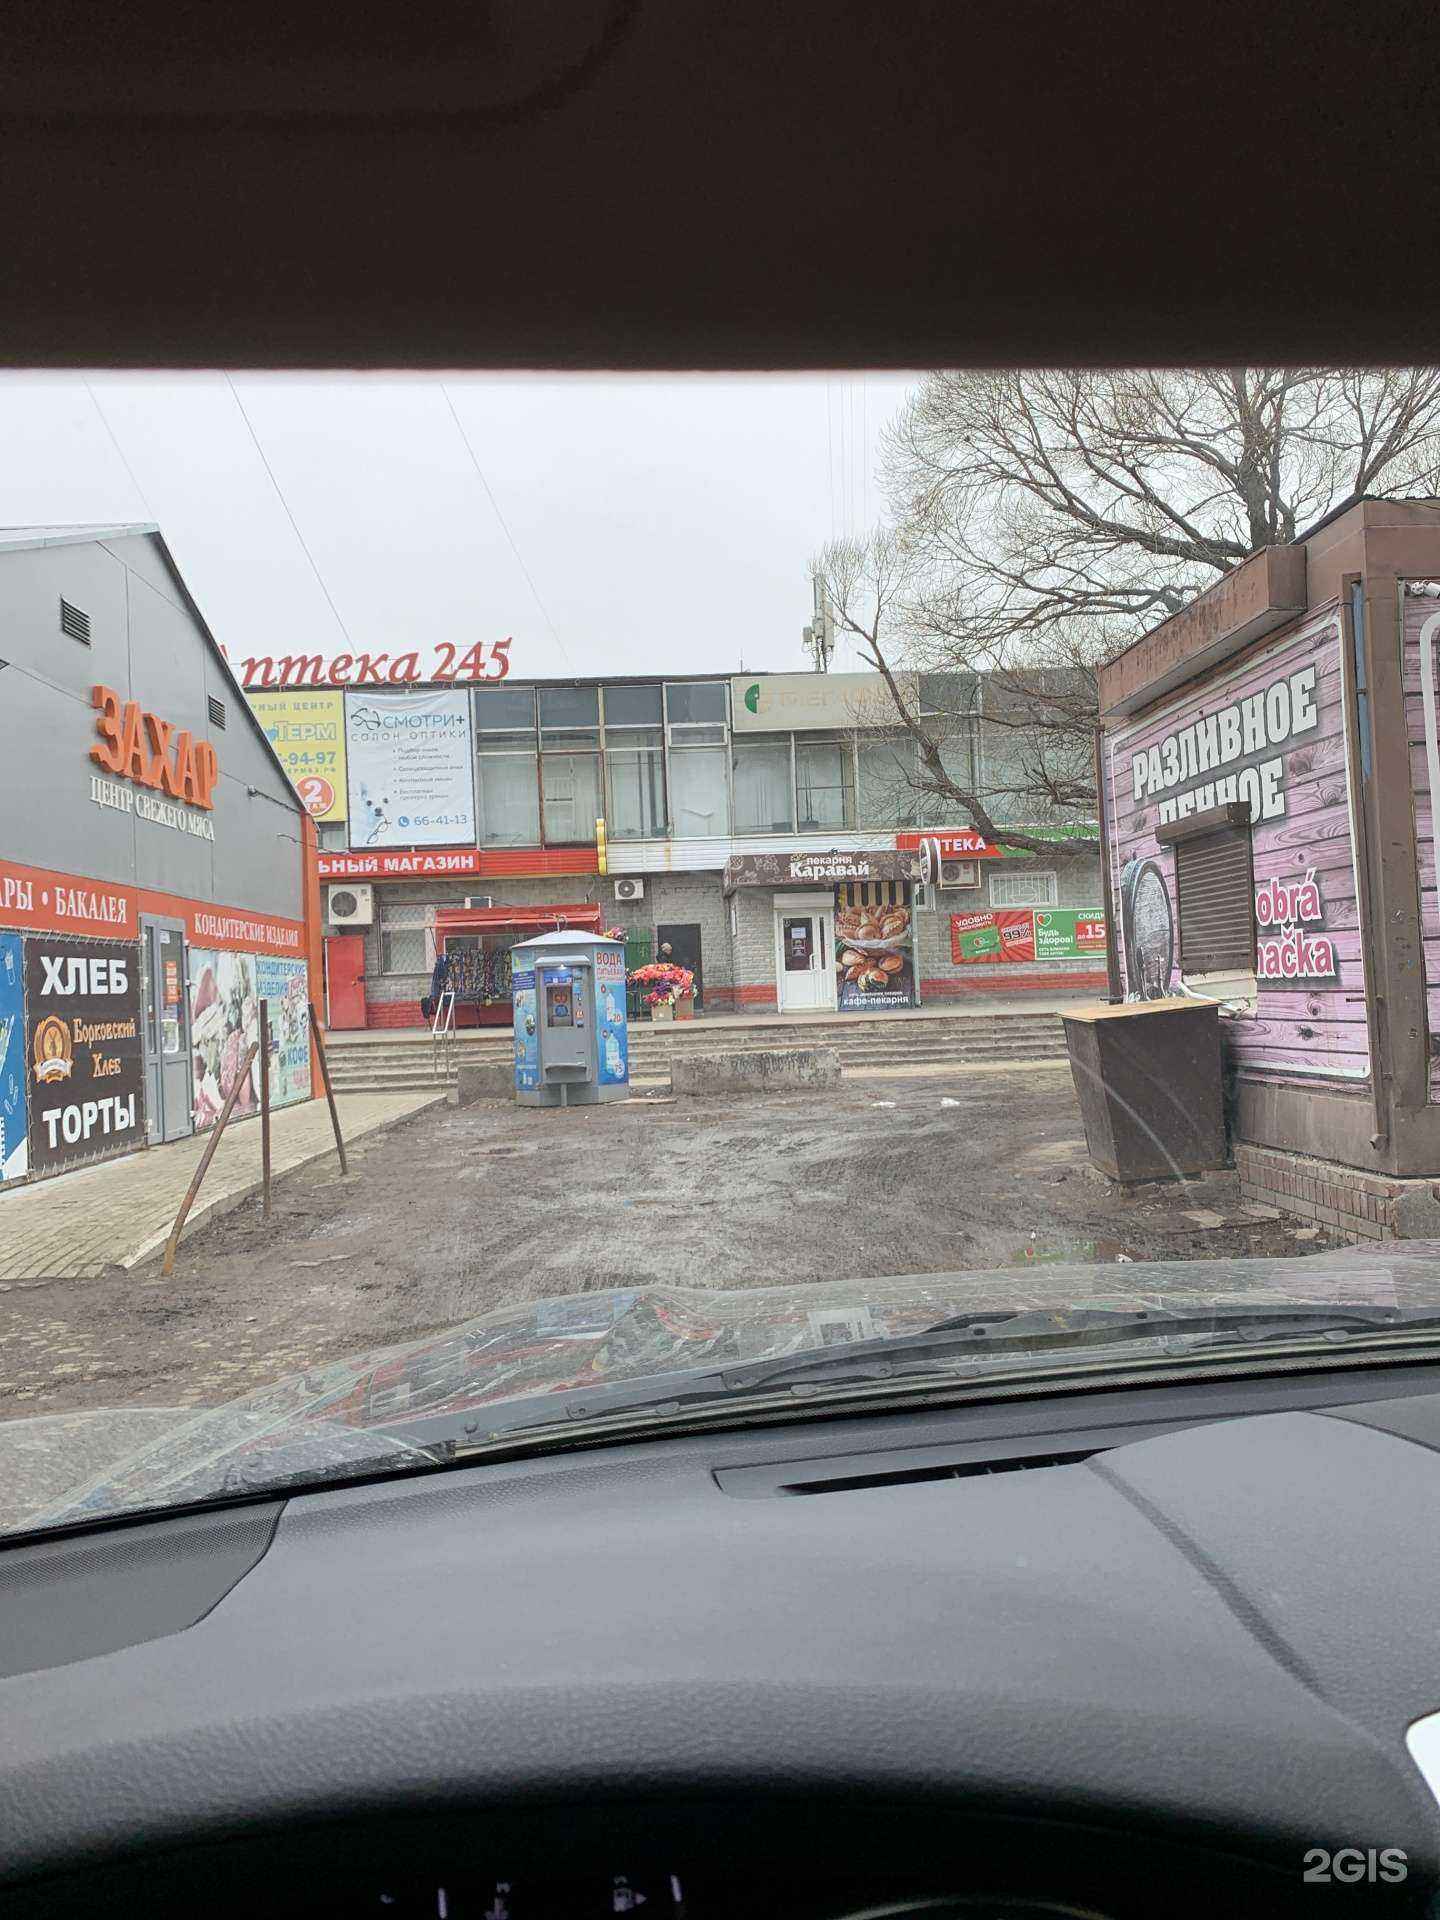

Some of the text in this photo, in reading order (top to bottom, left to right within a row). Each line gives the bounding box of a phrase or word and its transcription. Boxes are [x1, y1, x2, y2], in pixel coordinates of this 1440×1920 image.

[220, 637, 513, 688] птека 245
[250, 702, 334, 711] НЫЙ ЦЕНТР
[89, 684, 218, 811] ЗАХАР
[1133, 667, 1318, 800] РАЗЛИВНОЕ
[277, 752, 336, 766] -94-97
[303, 780, 324, 803] 2
[90, 775, 215, 842] ЦЕНТР СВЕЖЕГО МЯСА
[413, 815, 468, 826] 66-41-13
[929, 836, 987, 853] ТЕКА
[383, 855, 475, 872] МАГАЗИН
[789, 861, 870, 880] Каравай
[55, 886, 129, 924] БАКАЛЕЯ
[194, 913, 299, 948] КОНДИТЕРСКИЕ ИЗДЕЛИЯ
[596, 951, 622, 966] ВОДА
[40, 955, 129, 997] ХЛЕБ
[72, 1017, 136, 1048] Борковский
[42, 1093, 136, 1150] ТОРТЫ
